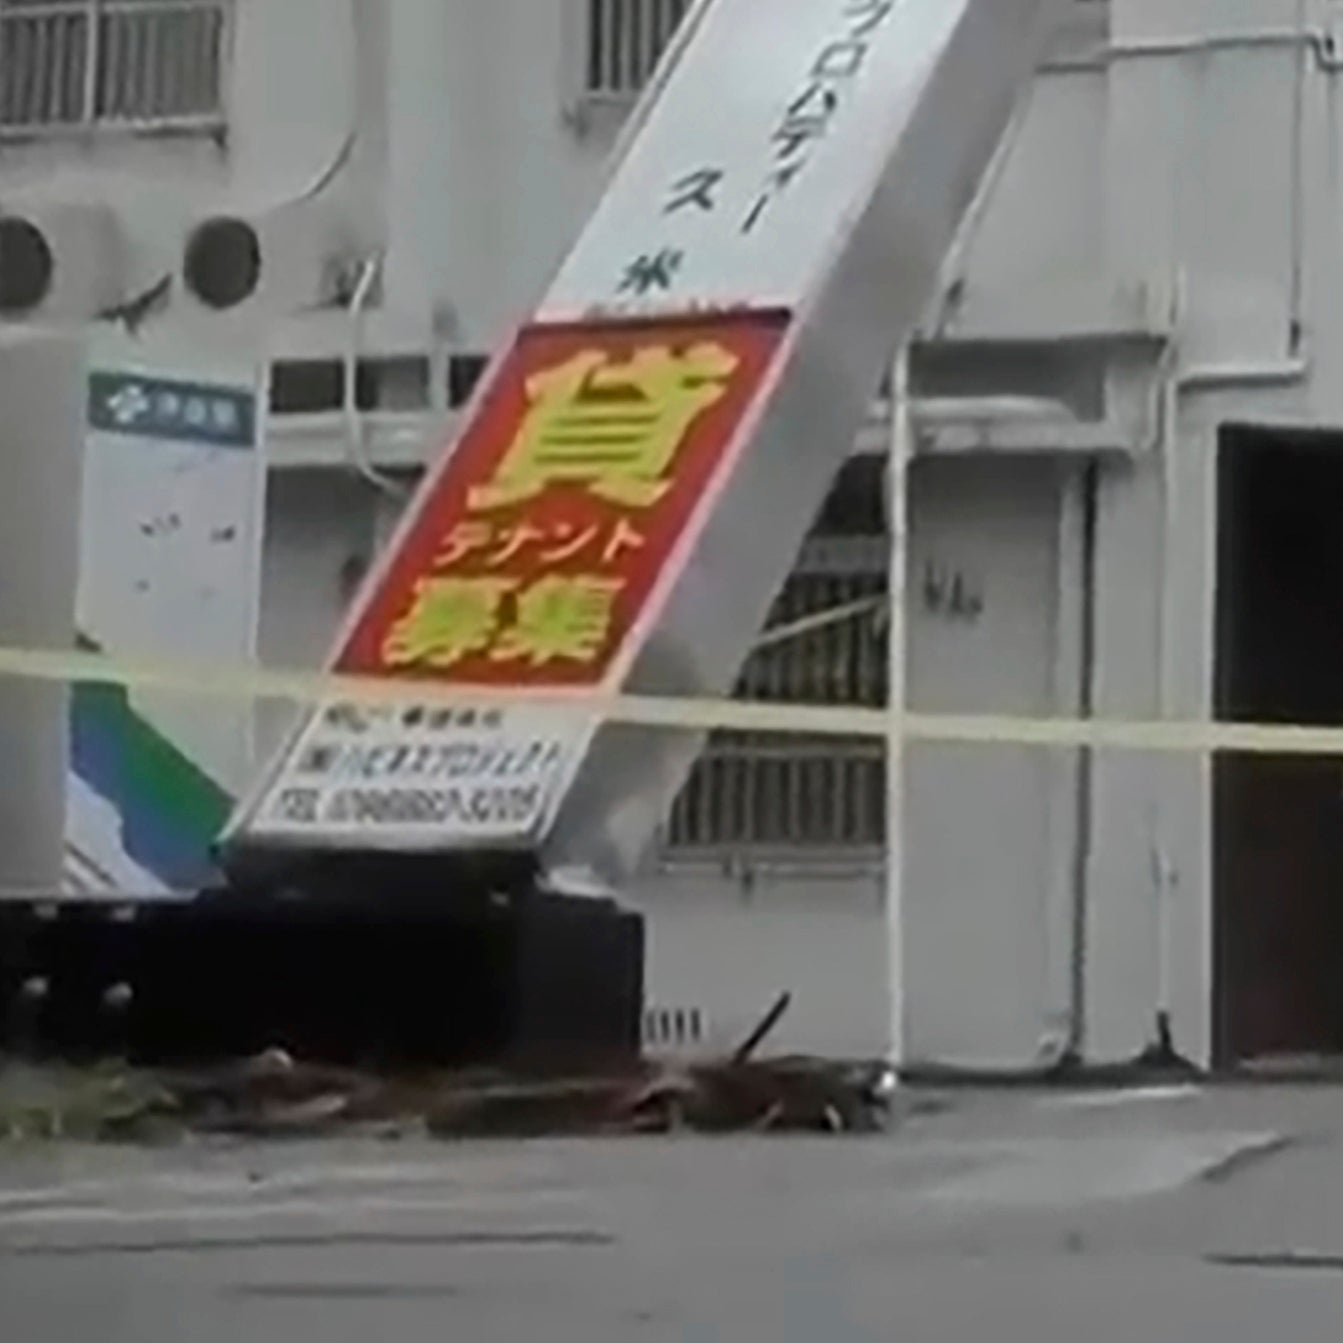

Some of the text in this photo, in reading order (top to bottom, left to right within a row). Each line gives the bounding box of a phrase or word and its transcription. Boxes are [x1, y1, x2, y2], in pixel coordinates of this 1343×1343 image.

[466, 339, 740, 509] 貸
[432, 518, 647, 566] テナント
[380, 573, 629, 668] 募集
